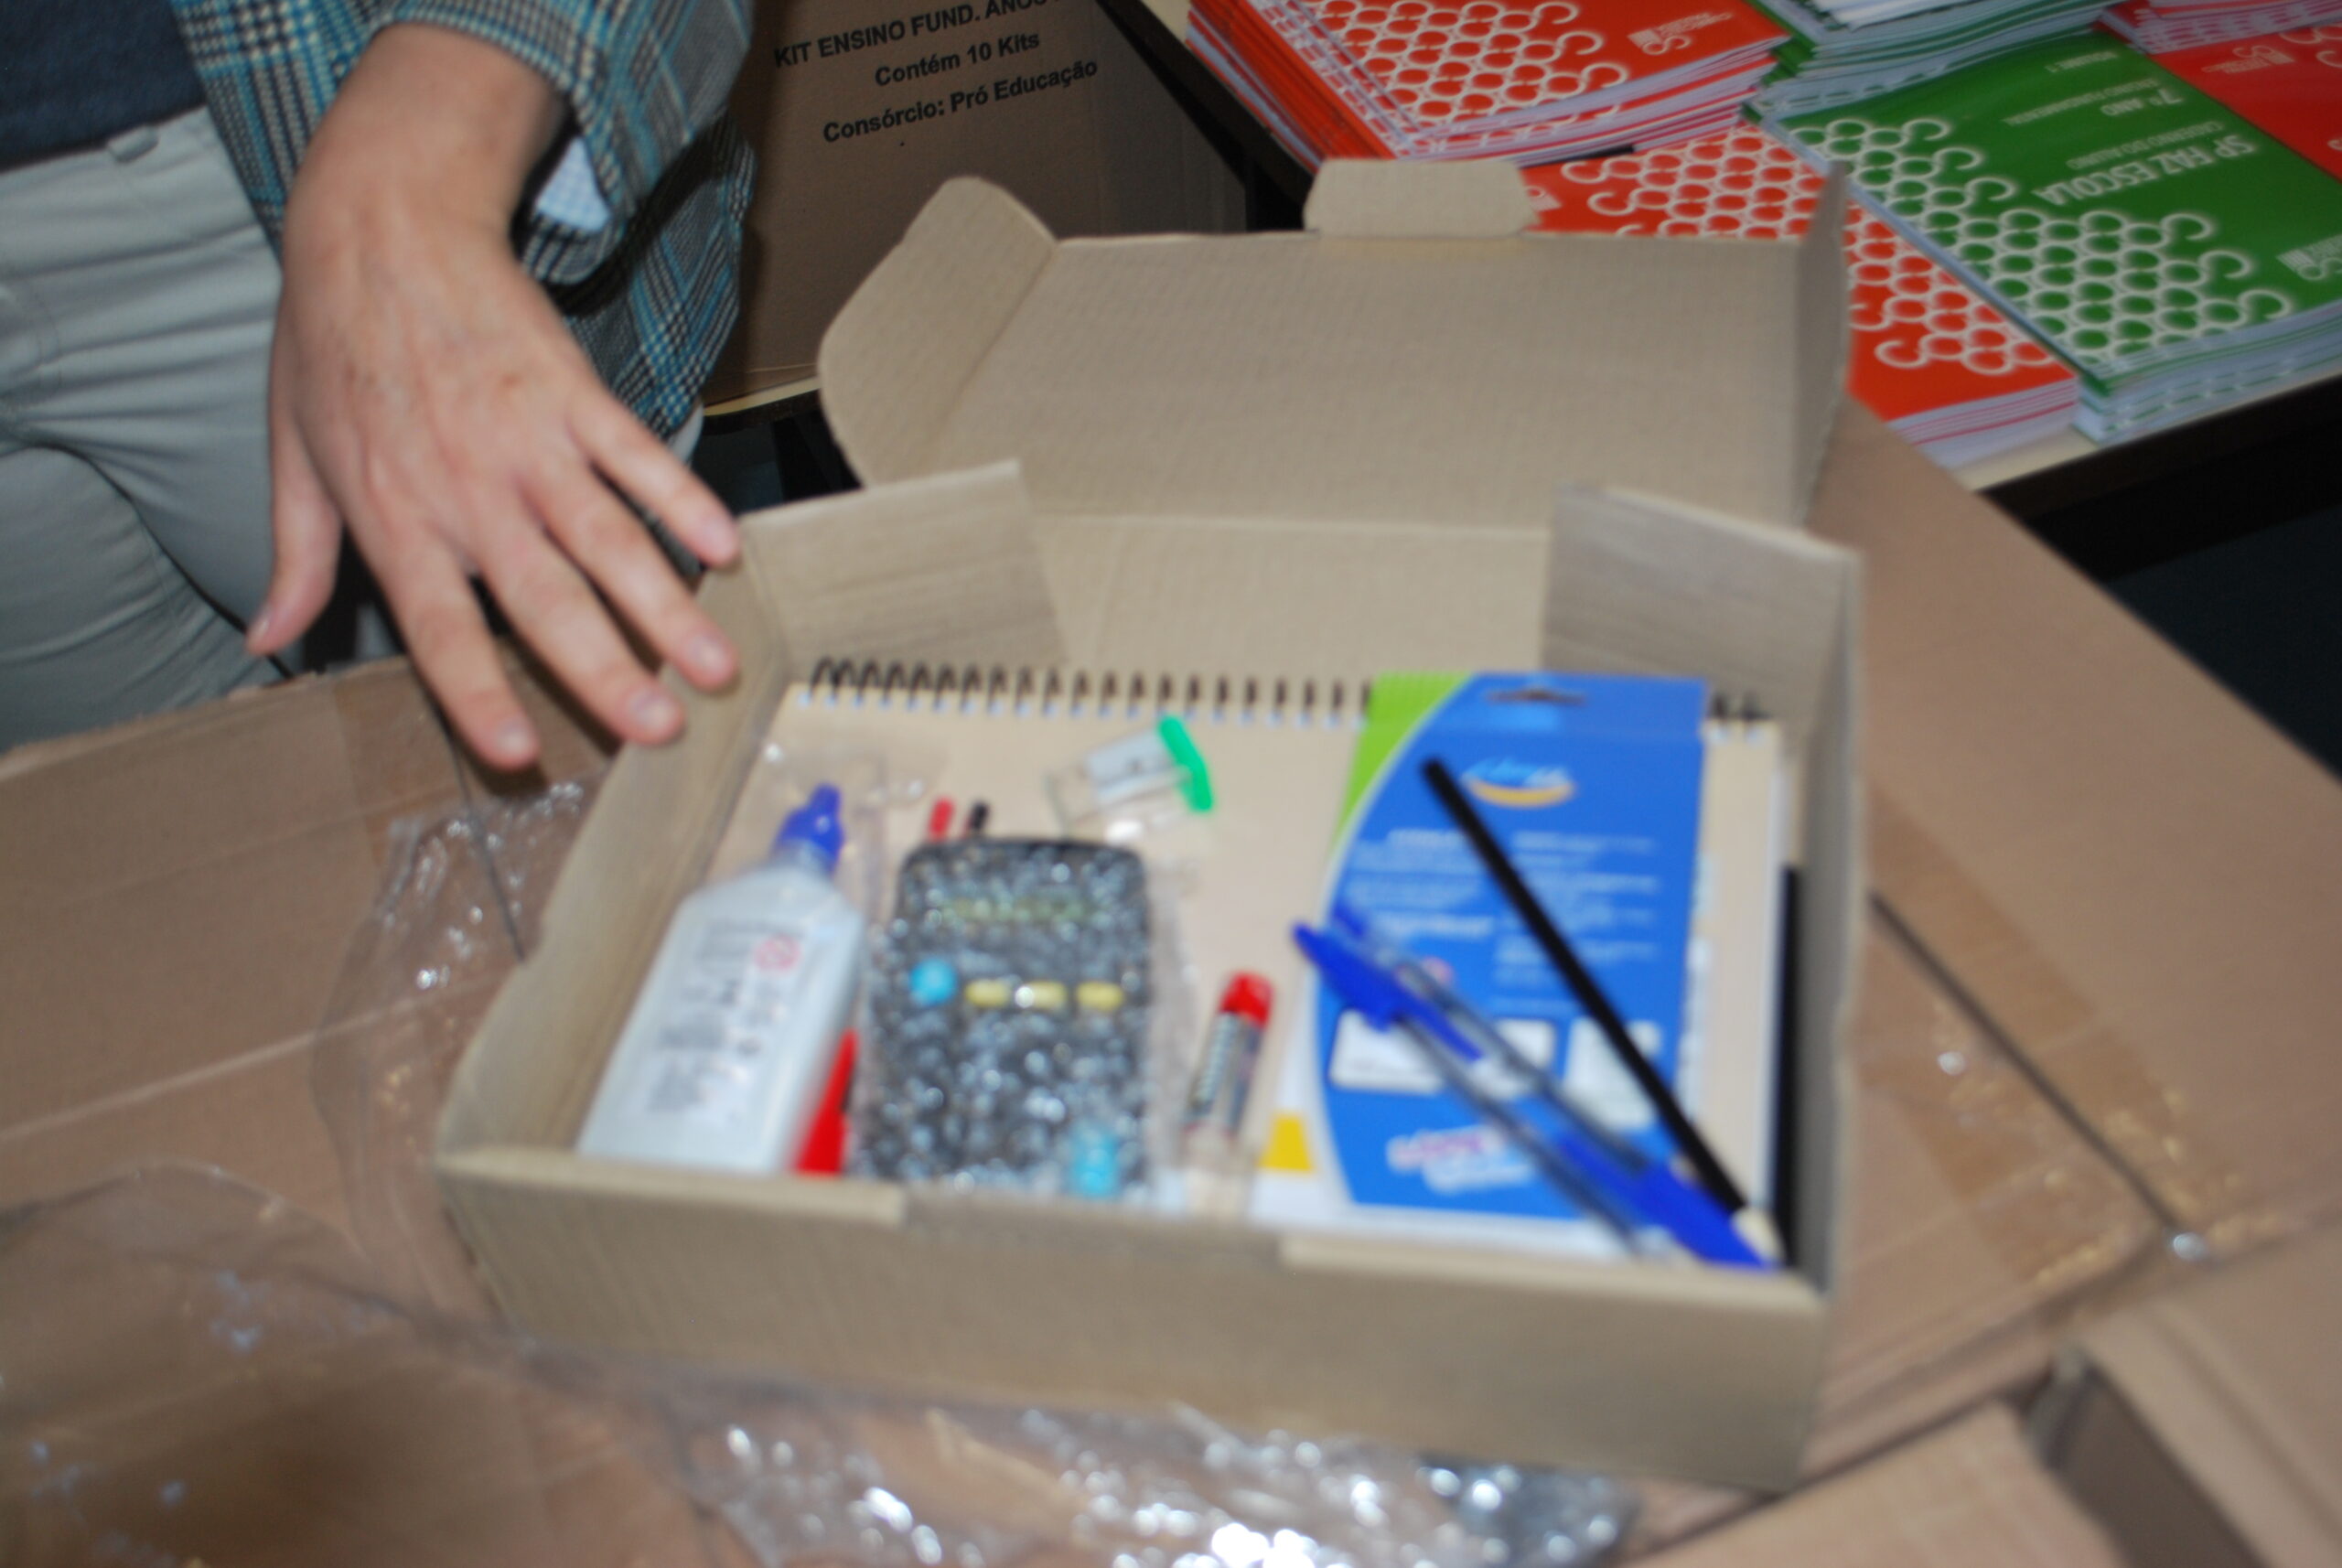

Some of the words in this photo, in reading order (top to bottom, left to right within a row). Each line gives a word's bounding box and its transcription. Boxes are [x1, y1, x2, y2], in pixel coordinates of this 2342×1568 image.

[773, 41, 811, 69] KIT
[818, 20, 906, 59] ENSINO
[910, 4, 983, 38] FUND.
[875, 53, 962, 87] Contém
[967, 43, 993, 66] 10
[998, 33, 1040, 56] Kits
[823, 100, 946, 142] Consórcio:
[951, 84, 988, 113] Pró
[994, 59, 1098, 101] Educação
[2147, 145, 2214, 175] FAZ
[2213, 134, 2255, 156] SP
[2031, 161, 2157, 206] ESCOLA
